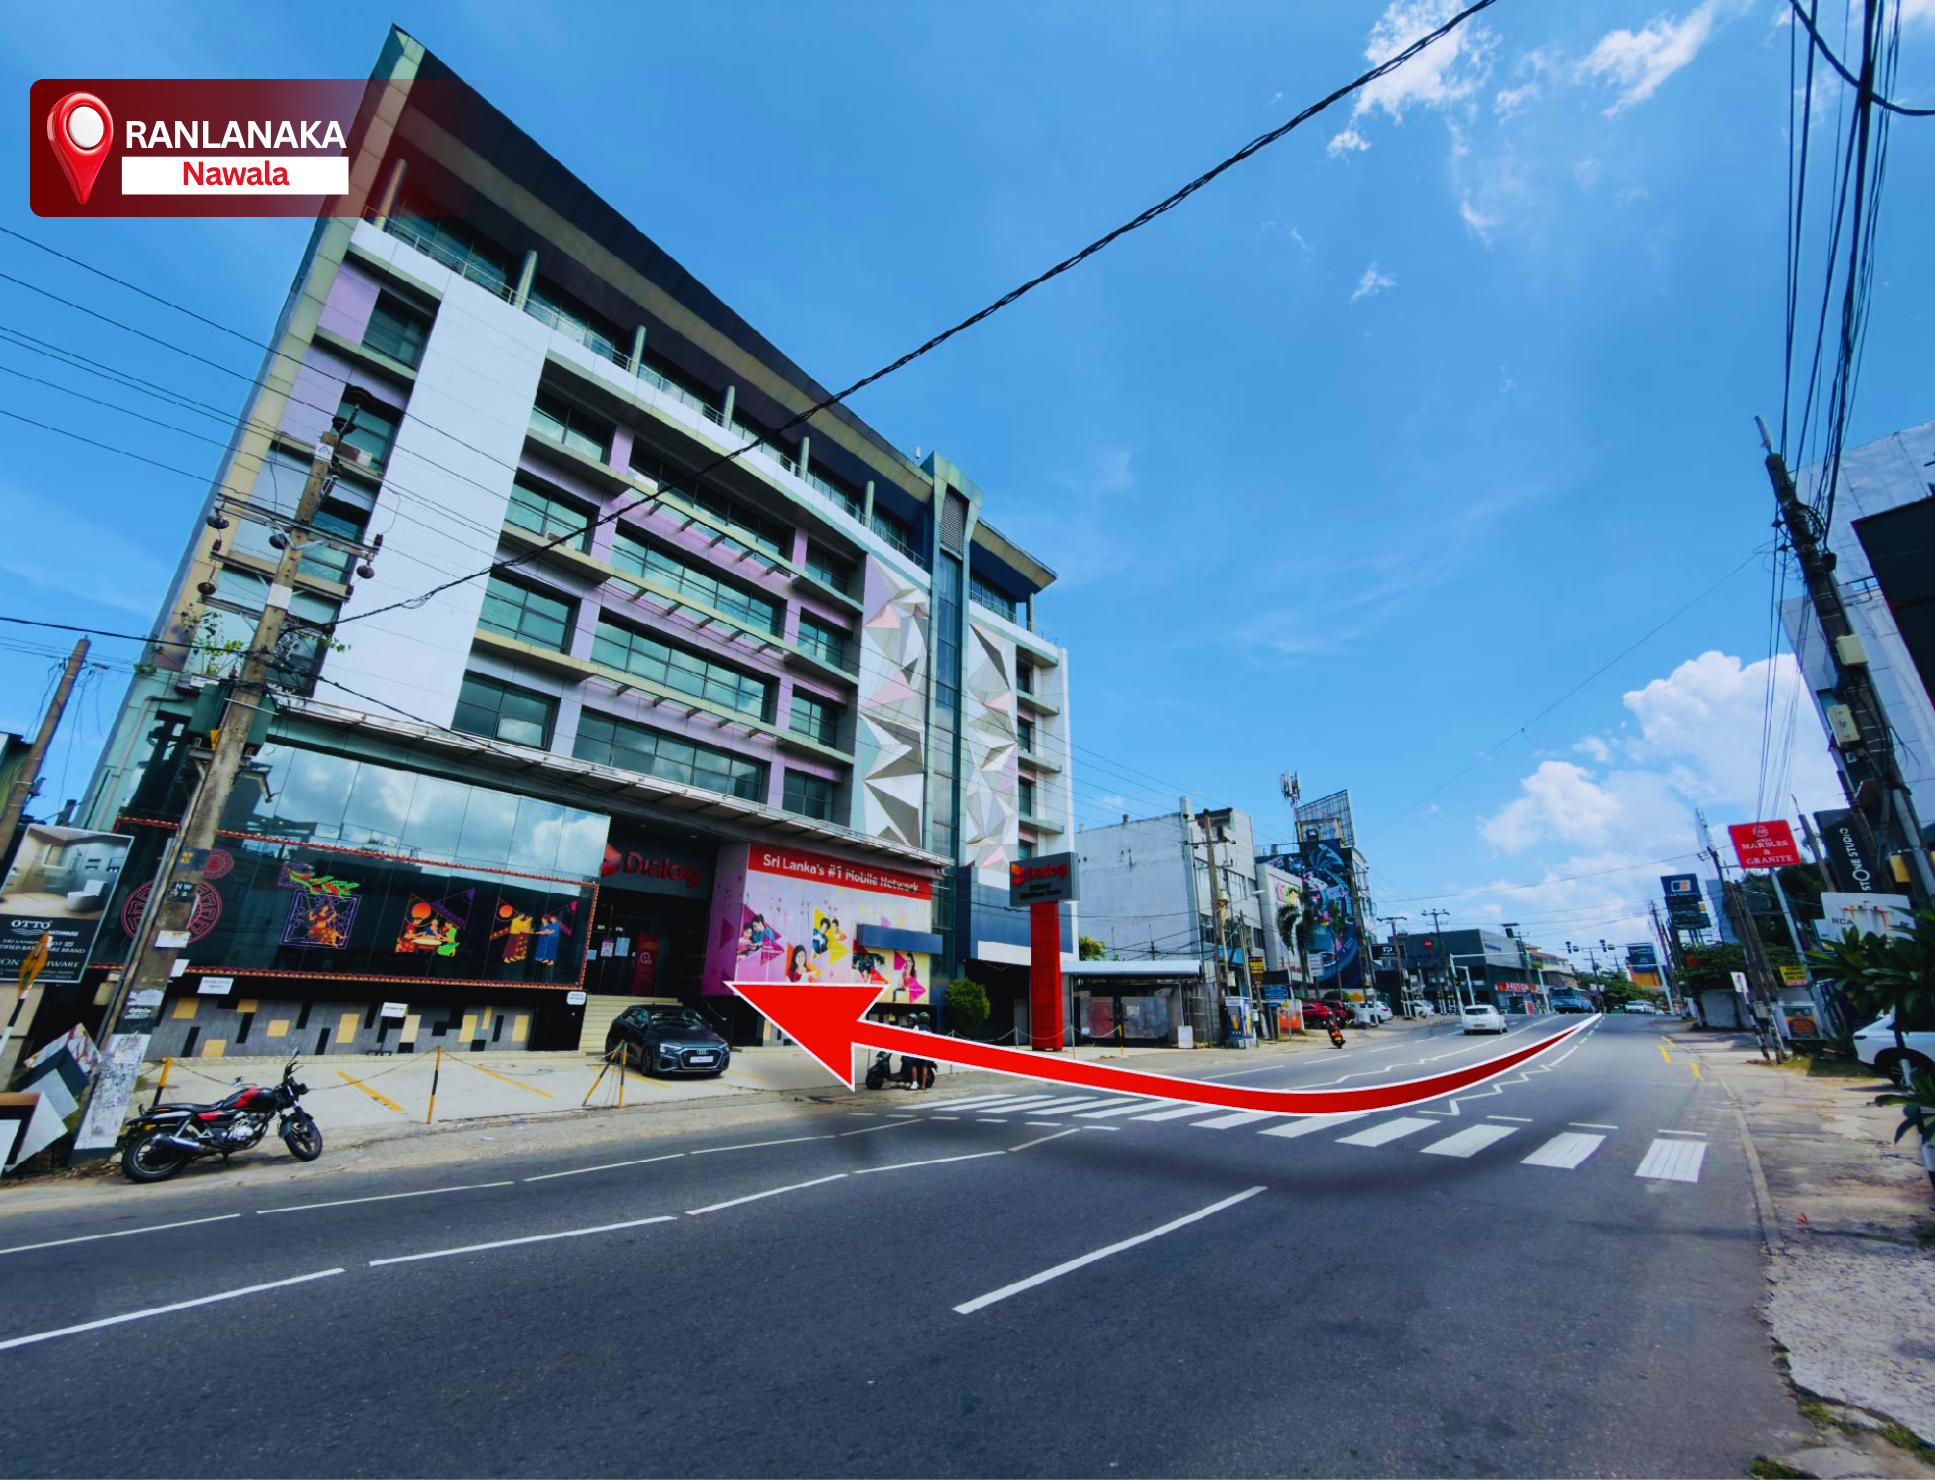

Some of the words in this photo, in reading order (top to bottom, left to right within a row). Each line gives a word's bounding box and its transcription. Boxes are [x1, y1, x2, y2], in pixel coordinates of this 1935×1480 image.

[1839, 827, 1858, 858] STUDIO
[624, 850, 700, 889] Dialog
[763, 853, 780, 868] Sri
[782, 857, 825, 877] Lanka's
[827, 863, 842, 880] #1
[845, 869, 879, 887] Mobile
[1026, 863, 1068, 880] Dialog
[1746, 855, 1793, 865] GRANITE
[1850, 858, 1872, 891] STONE
[11, 919, 51, 930] OTTO
